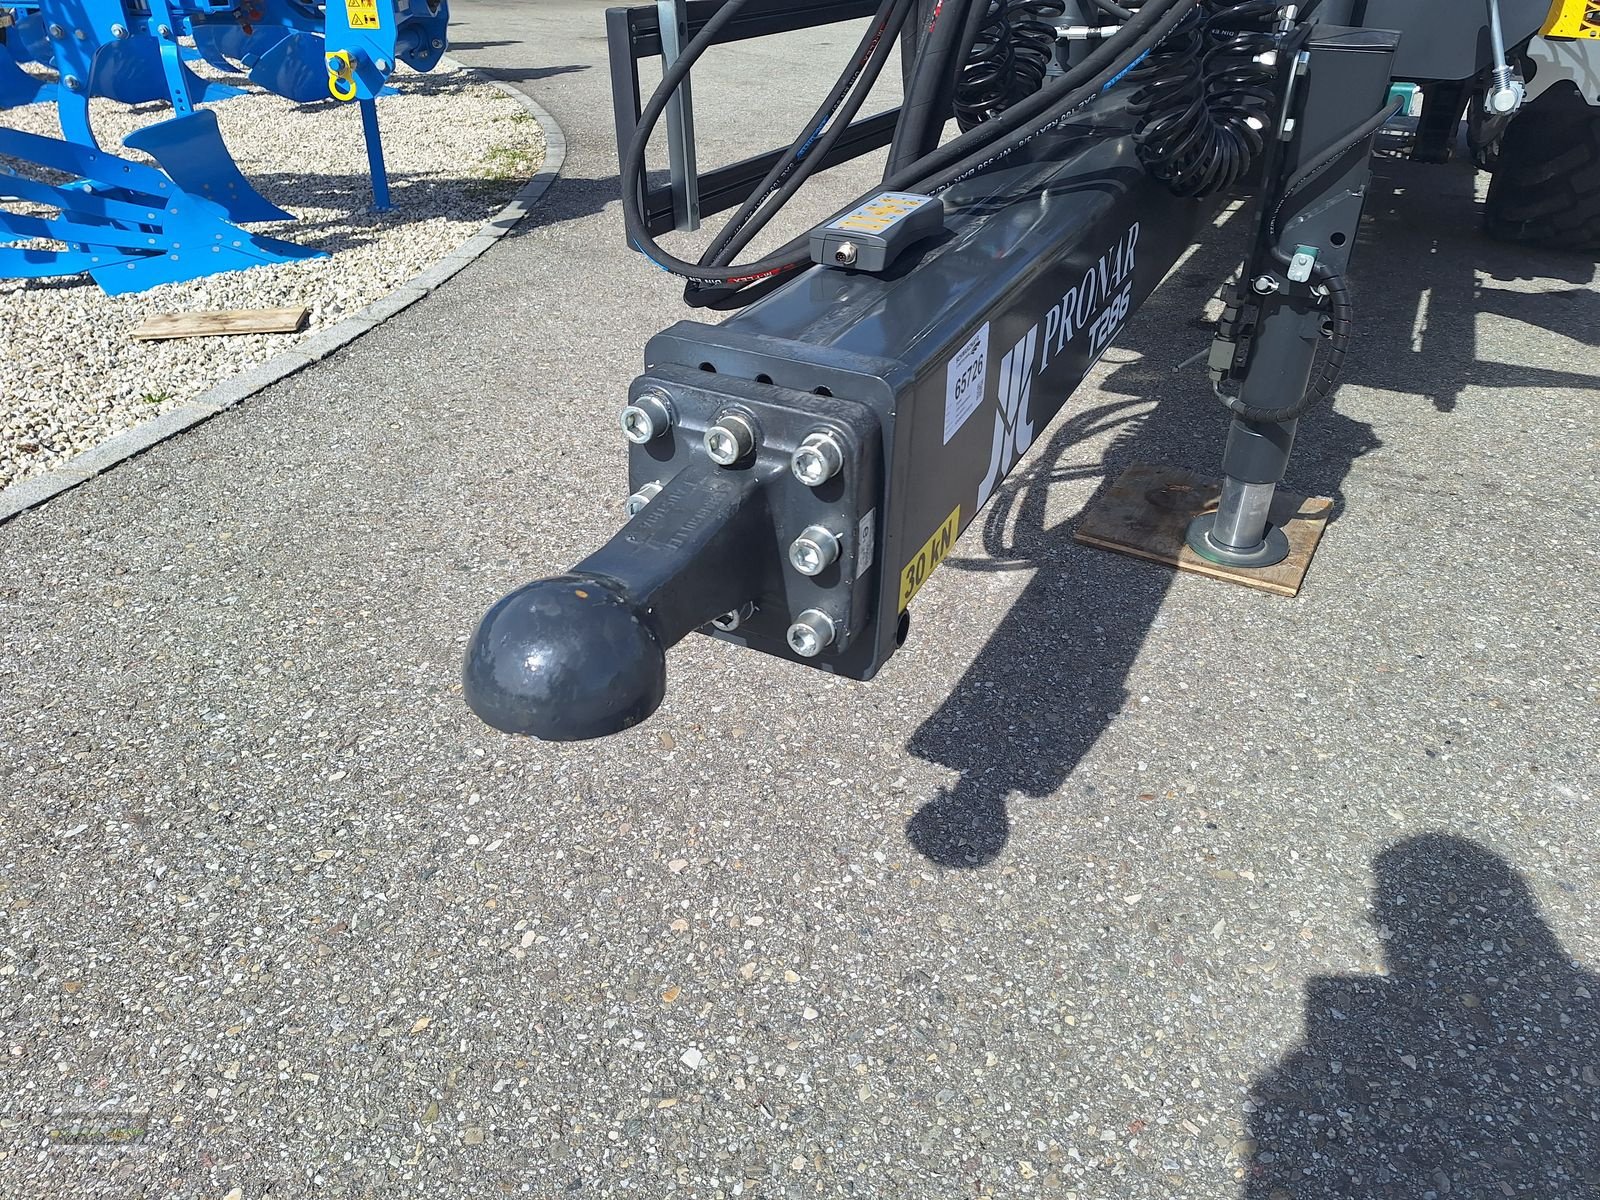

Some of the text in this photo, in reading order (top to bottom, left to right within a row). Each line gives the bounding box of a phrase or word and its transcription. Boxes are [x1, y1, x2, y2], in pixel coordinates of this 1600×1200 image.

[1038, 221, 1139, 376] PRONAR
[954, 353, 984, 400] 65726
[904, 518, 953, 599] 30 kN
